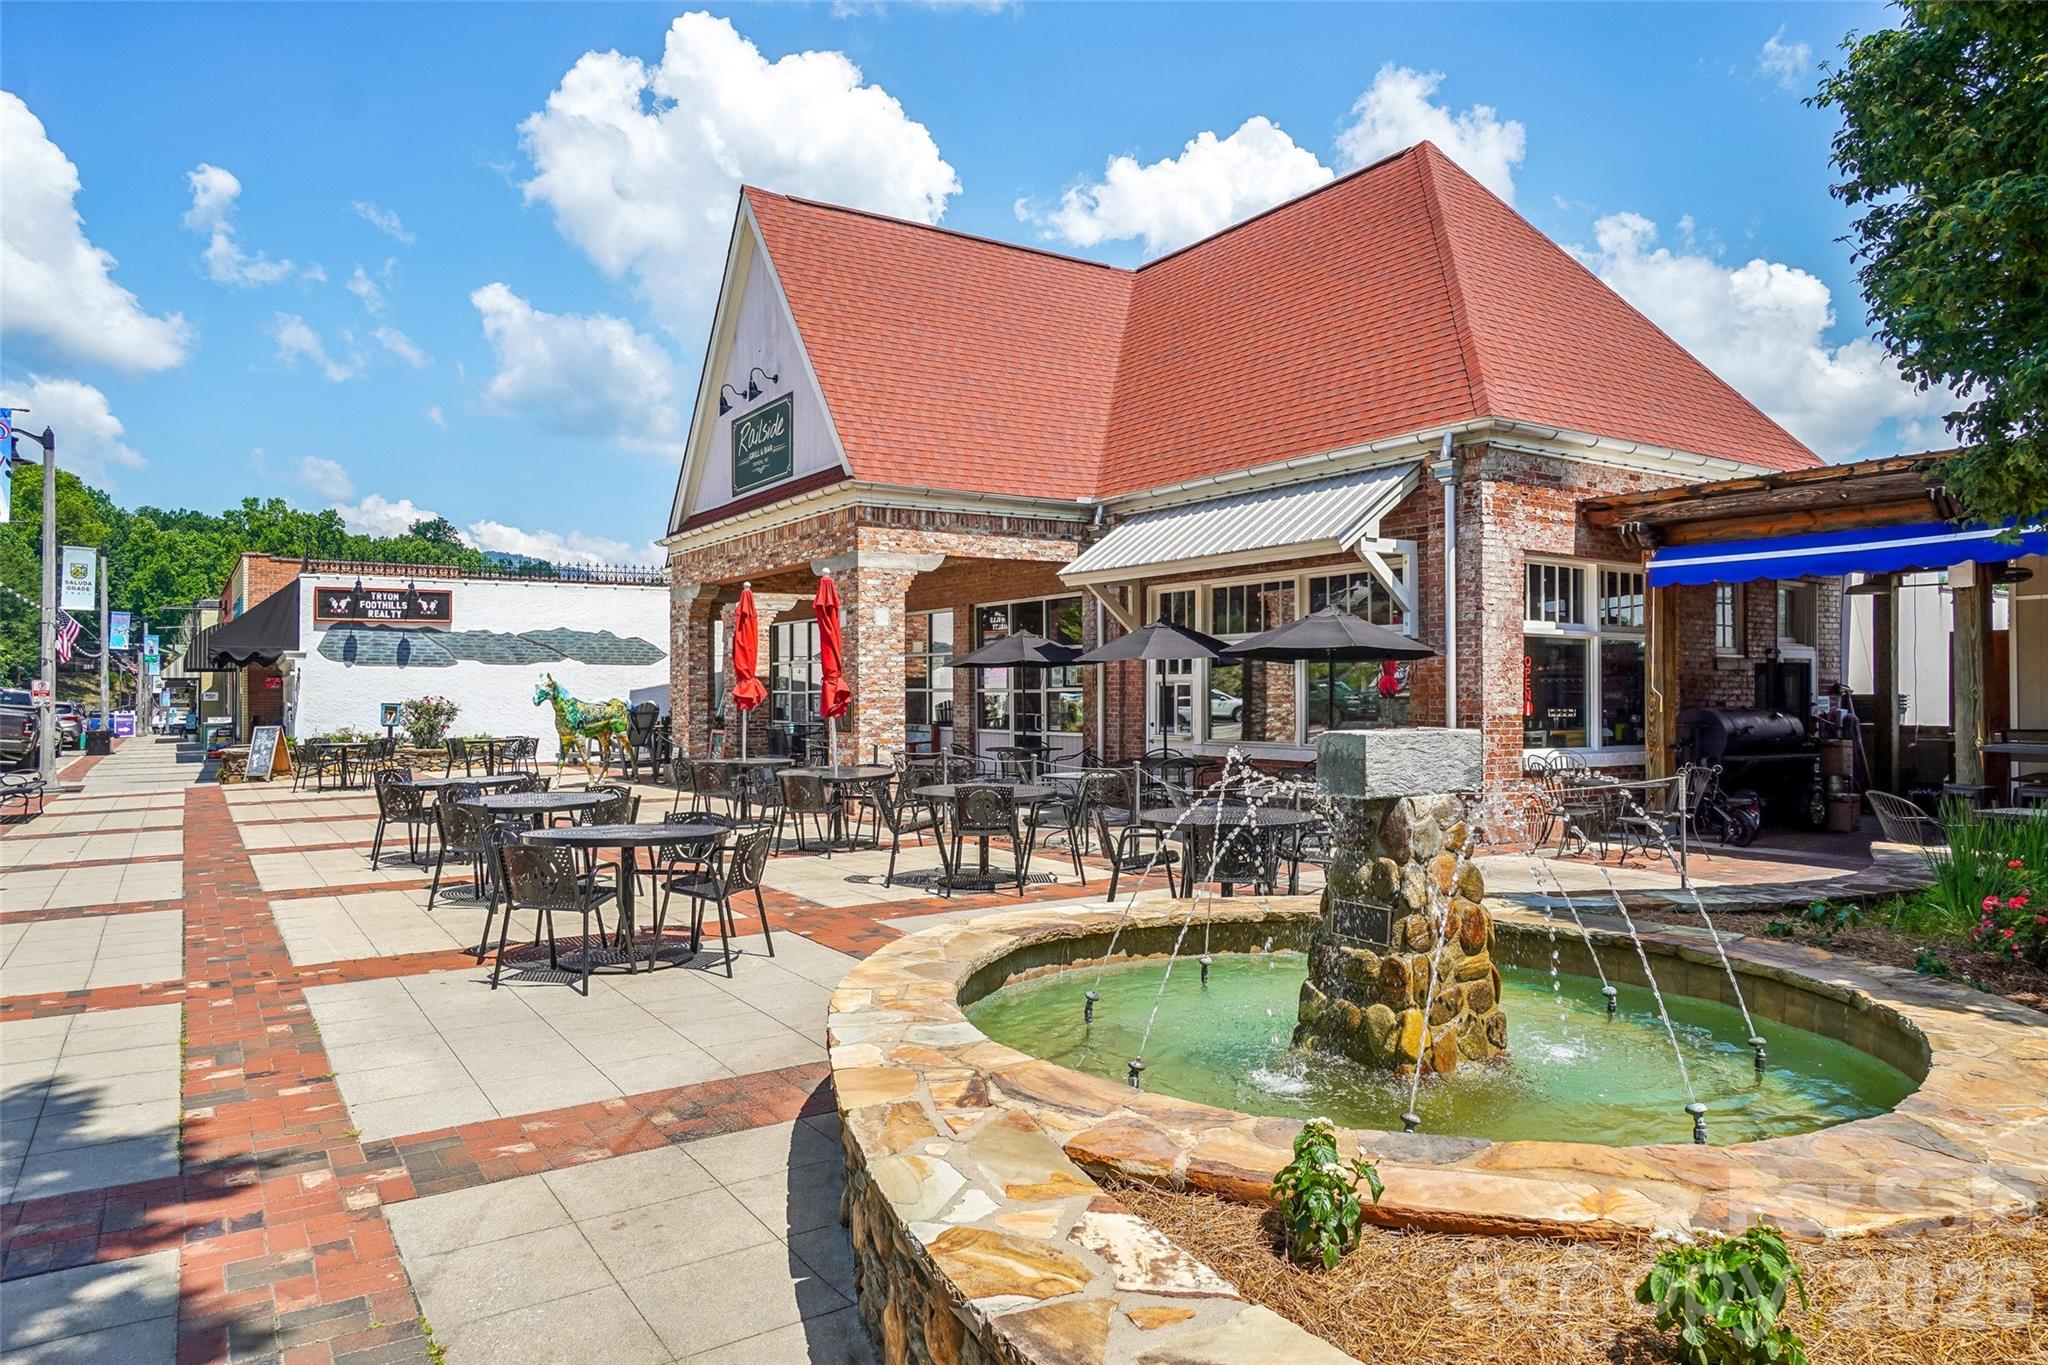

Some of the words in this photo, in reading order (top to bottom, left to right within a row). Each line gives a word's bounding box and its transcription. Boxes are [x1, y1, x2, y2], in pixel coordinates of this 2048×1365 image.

[739, 412, 784, 456] Railside
[371, 592, 399, 601] TRYON
[360, 601, 407, 609] FOOTHILLS
[368, 610, 401, 618] REALTY
[1524, 656, 1532, 701] OPEN
